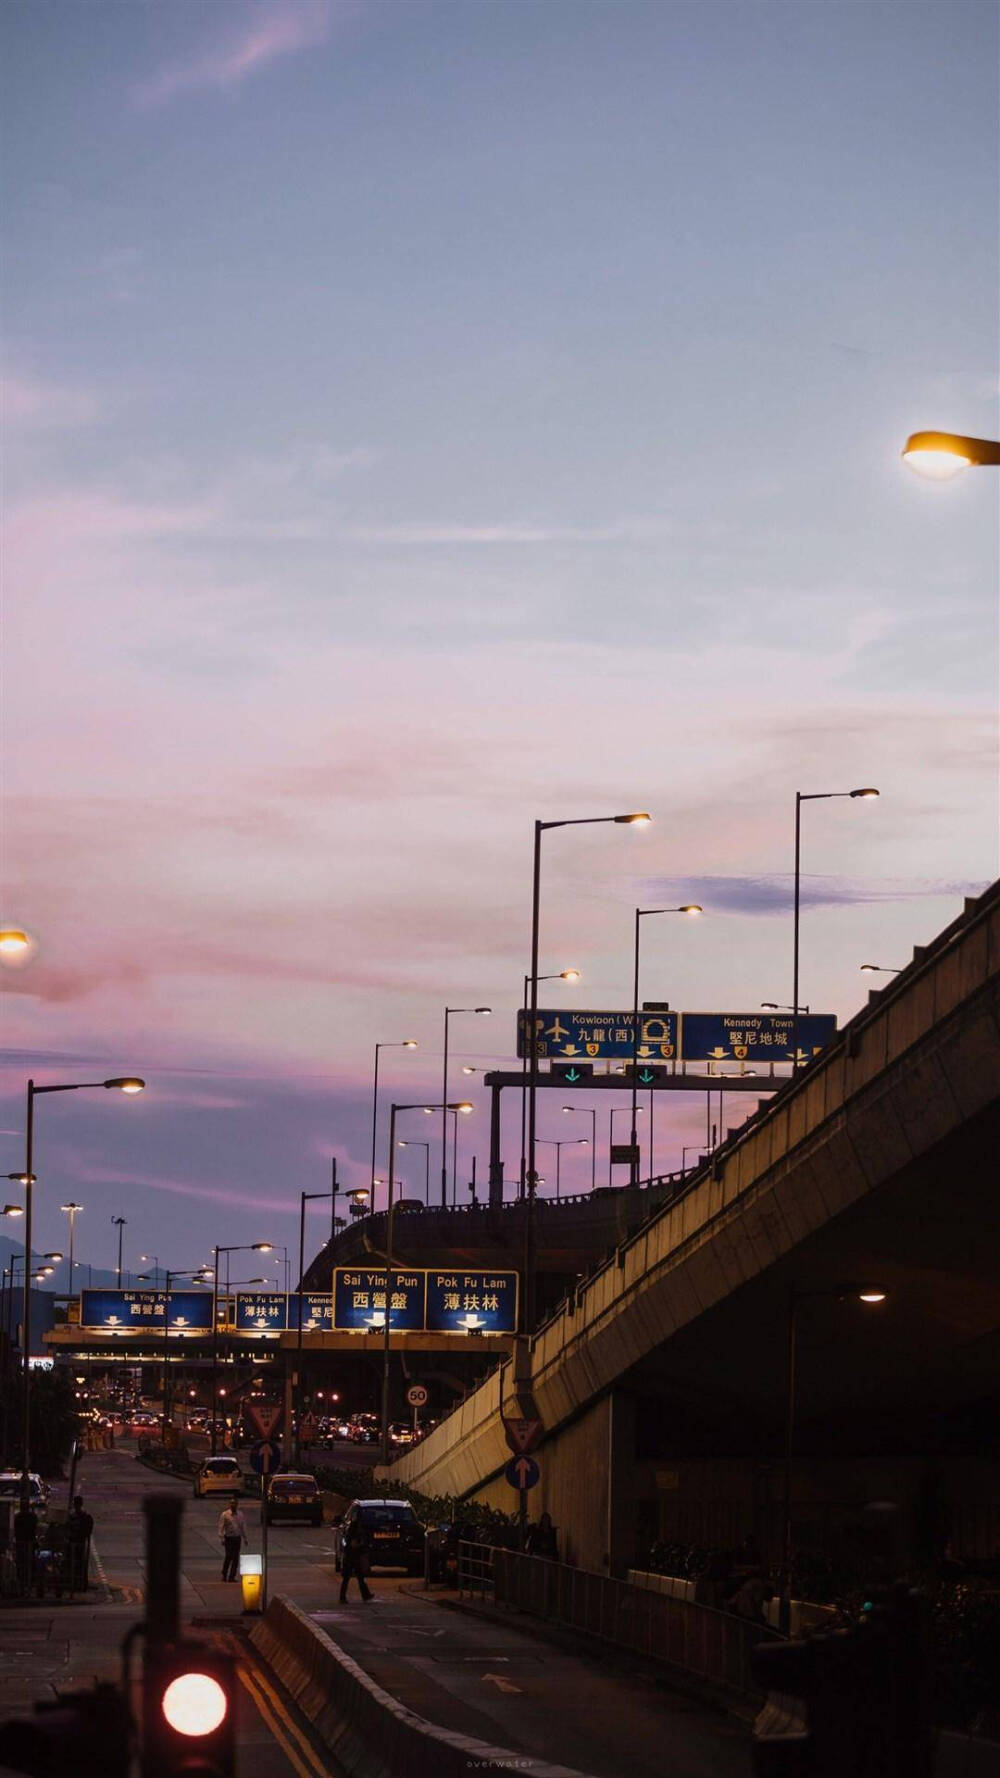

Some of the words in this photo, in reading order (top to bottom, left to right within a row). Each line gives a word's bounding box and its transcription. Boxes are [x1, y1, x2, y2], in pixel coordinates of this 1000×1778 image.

[572, 1015, 614, 1024] Kowloon
[723, 1018, 762, 1029] Kennedy
[770, 1018, 794, 1028] Town
[729, 1031, 788, 1045] 堅尼地城
[663, 1046, 671, 1056] 3
[343, 1274, 361, 1286] Sai
[396, 1275, 418, 1287] Pun
[437, 1276, 458, 1288] Pok
[464, 1277, 477, 1288] Fu
[483, 1277, 507, 1288] Lam
[124, 1293, 135, 1301] Sai
[353, 1291, 408, 1309] 西營盤
[443, 1292, 499, 1311] 薄扶林
[244, 1305, 280, 1317] 薄扶林
[410, 1391, 426, 1401] 50
